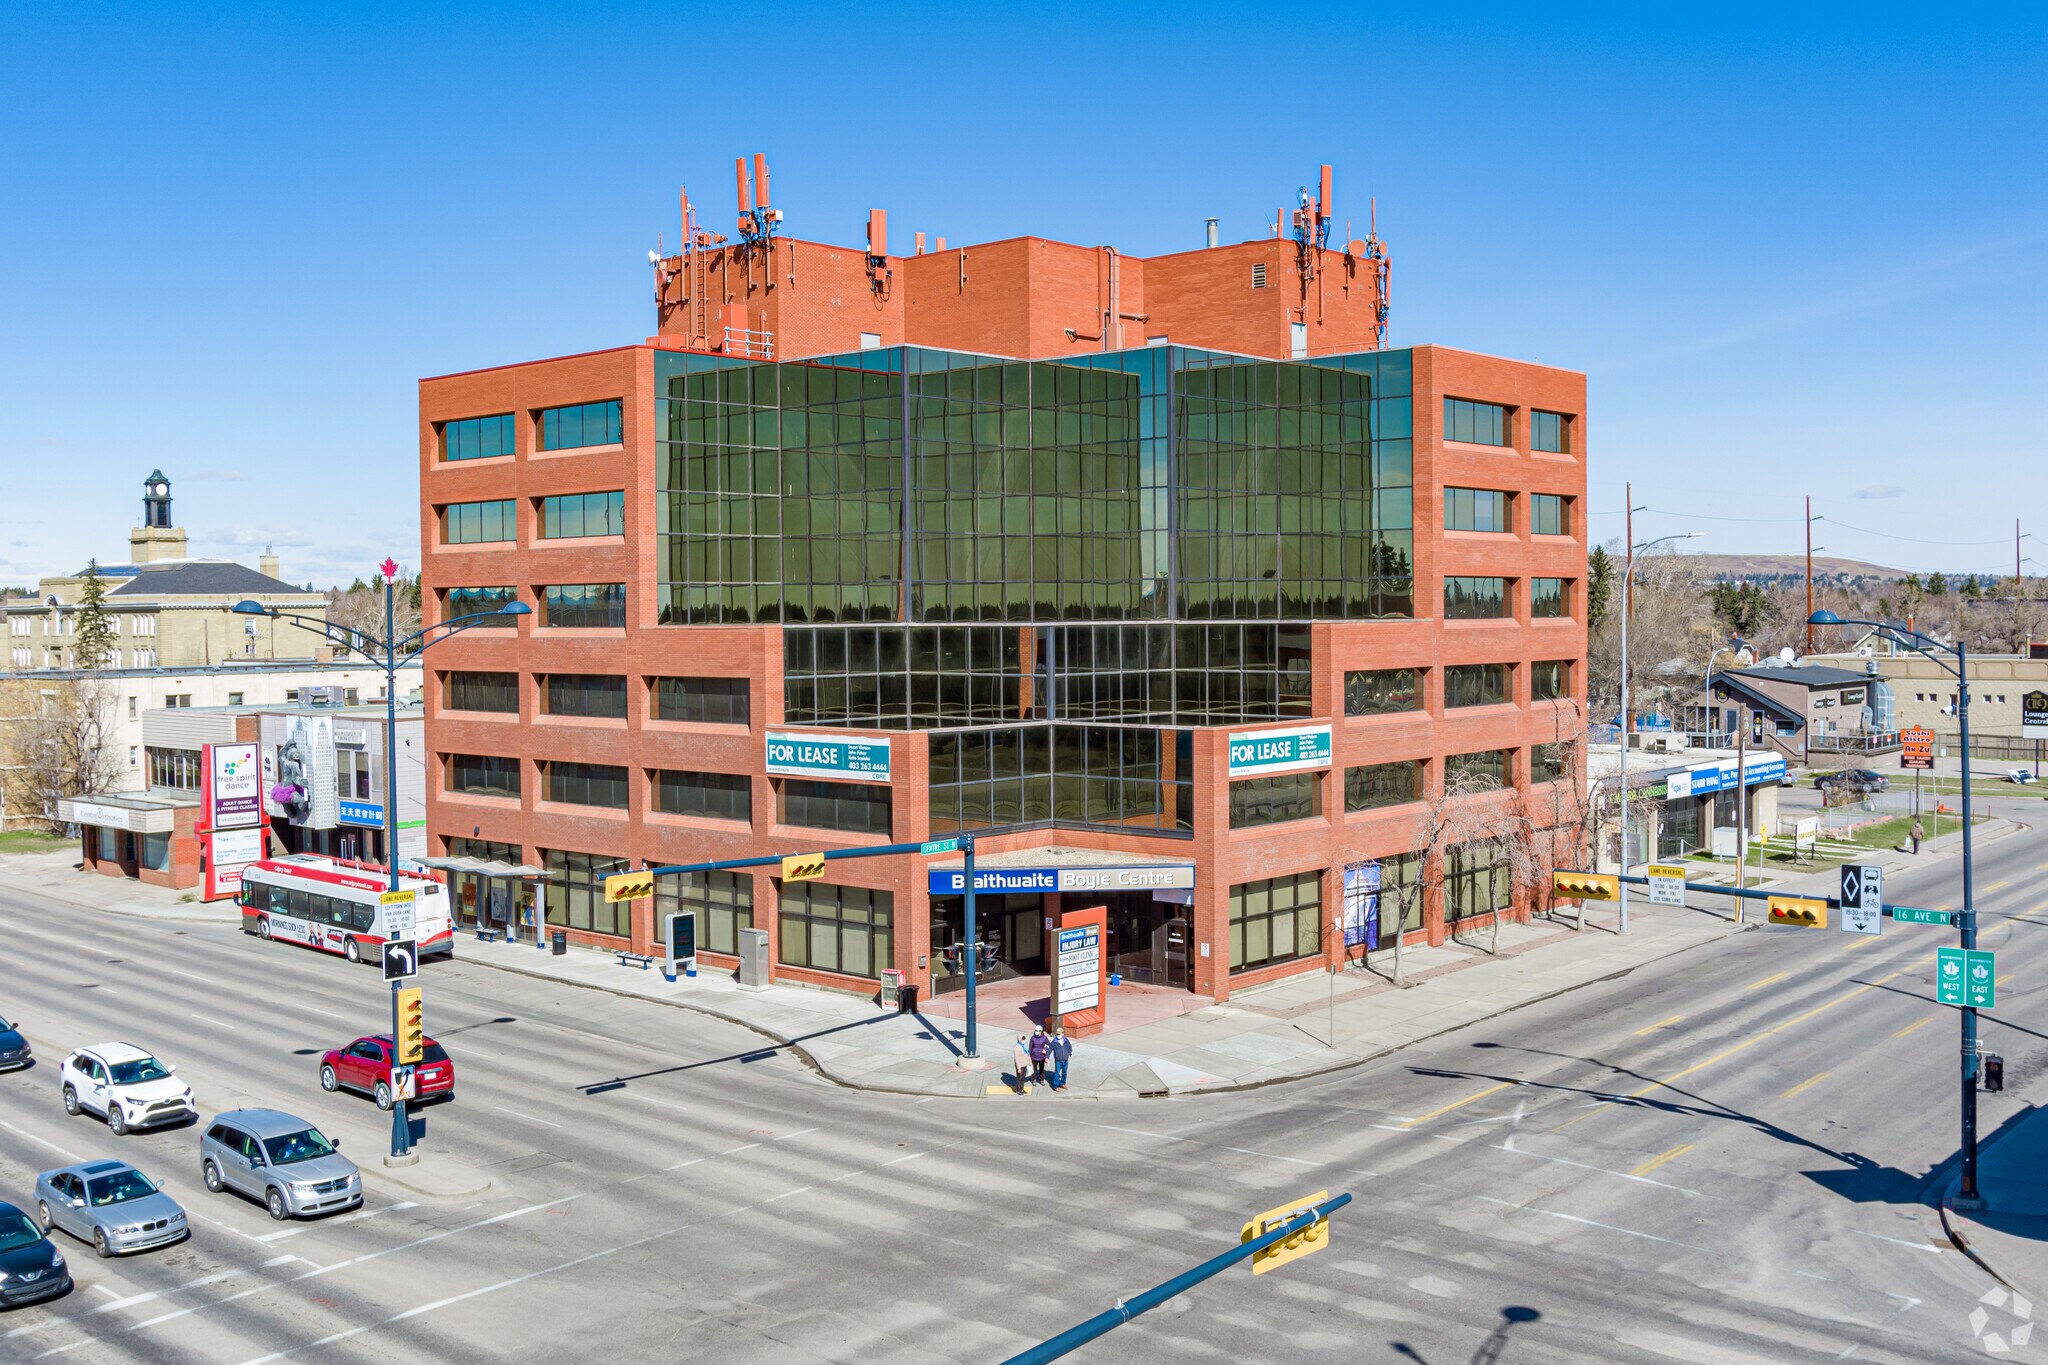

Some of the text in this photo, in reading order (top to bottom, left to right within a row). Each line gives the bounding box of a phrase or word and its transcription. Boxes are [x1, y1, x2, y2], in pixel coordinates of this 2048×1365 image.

[769, 745, 838, 764] FOR LEASE
[1232, 741, 1291, 762] FOR LEASE
[1309, 750, 1317, 758] 263
[848, 762, 859, 770] 403
[861, 762, 871, 770] 263
[1749, 765, 1769, 774] Accounting
[1770, 762, 1784, 771] Services
[236, 773, 256, 782] spirit
[1639, 784, 1667, 799] CANNABIS
[923, 844, 941, 853] CENTRE
[944, 842, 949, 850] ST
[952, 871, 1173, 889] Baithwaite Boyle Centre
[1898, 910, 1946, 922] 16 AVE N
[288, 922, 296, 932] SUCK
[1062, 936, 1097, 951] INJURY LAW
[1069, 953, 1080, 962] FOOT
[1972, 985, 1988, 994] EAST
